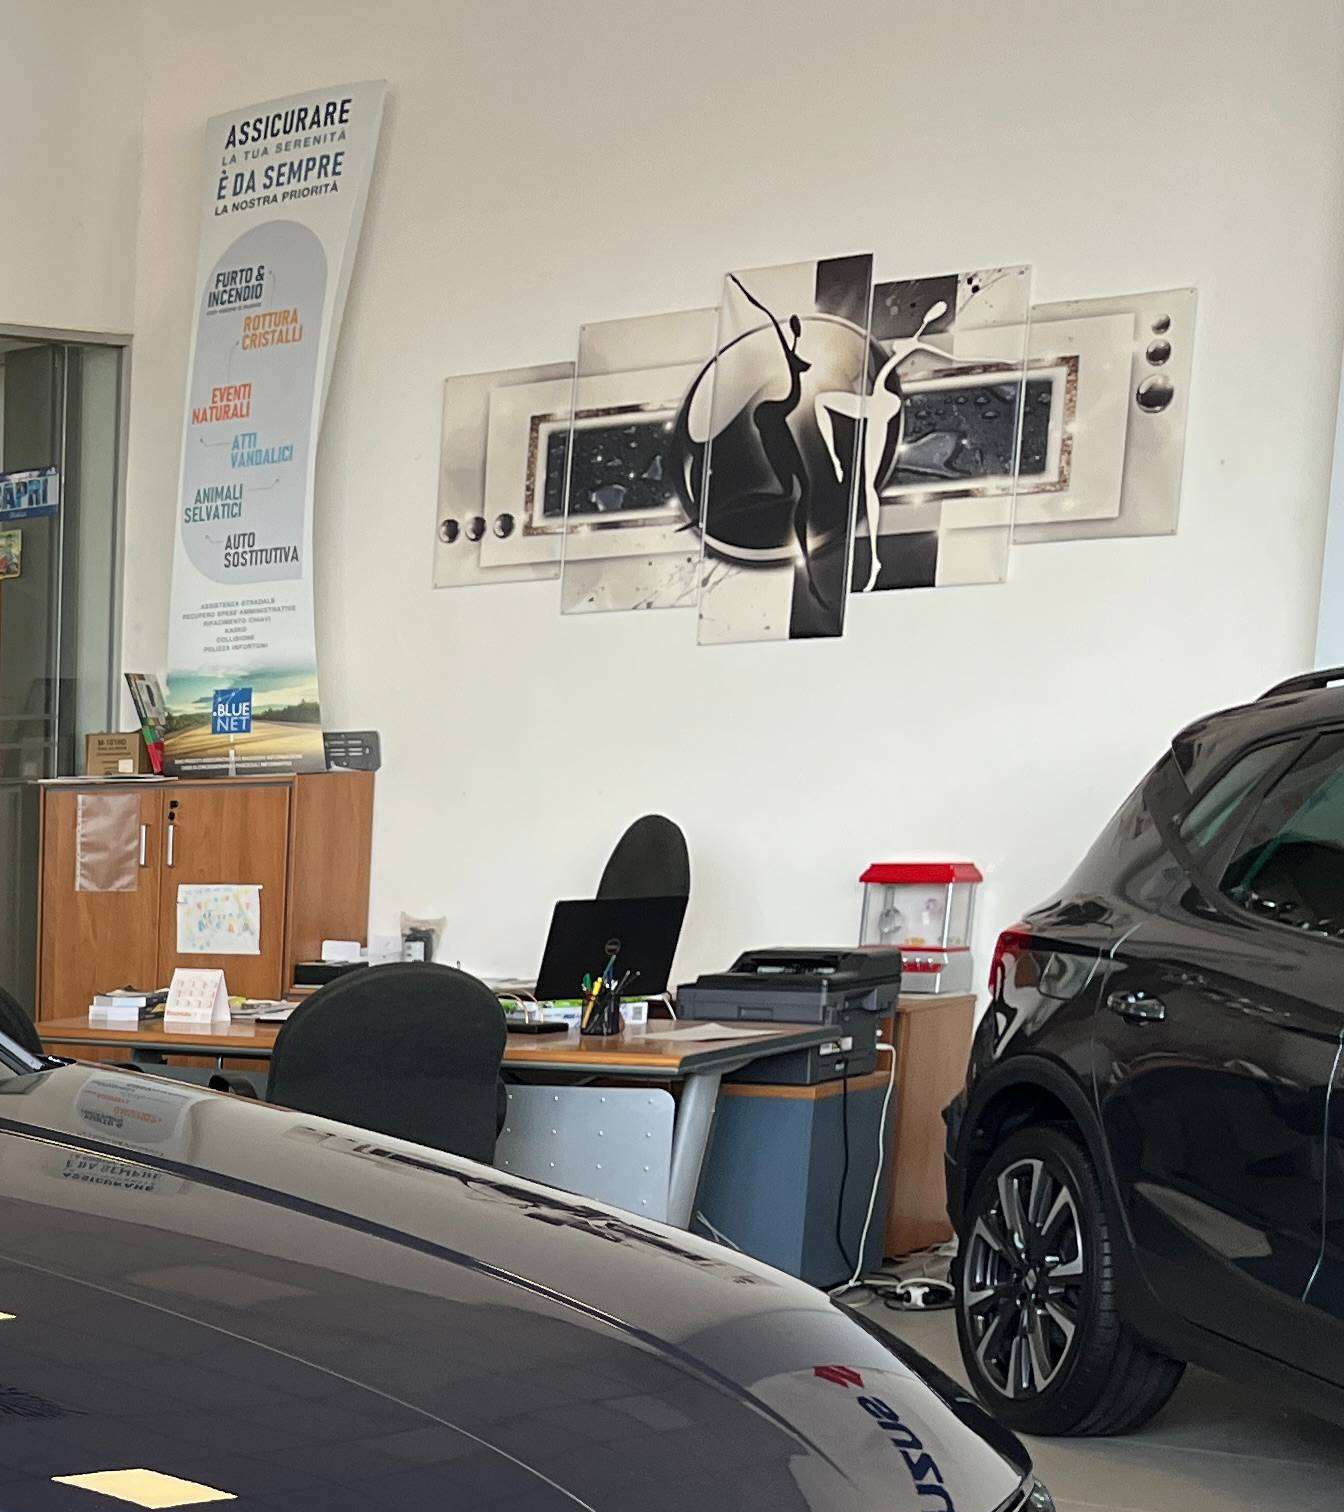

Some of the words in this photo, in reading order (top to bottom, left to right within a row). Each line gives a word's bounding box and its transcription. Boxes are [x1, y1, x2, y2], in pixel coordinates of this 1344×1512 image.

[224, 98, 353, 150] ASSICURARE
[221, 152, 238, 167] LA
[243, 146, 269, 162] TUA
[232, 169, 257, 197] DA
[262, 151, 346, 190] SEMPRE
[214, 203, 229, 217] LA
[231, 193, 279, 213] NOSTRA
[214, 267, 253, 290] FURTO
[254, 264, 265, 282] &
[207, 283, 264, 309] INCENDIO
[243, 308, 299, 333] ROTTURA
[241, 326, 304, 351] CRISTALLI
[210, 382, 252, 406] EVENTI
[191, 400, 252, 425] NATURALI
[231, 432, 258, 452] ATTI
[230, 445, 294, 469] VANDALICI
[193, 482, 244, 506] ANIMALI
[183, 501, 242, 524] SELVATICI
[224, 531, 256, 551] AUTO
[223, 544, 300, 569] SOSTITUTIVA
[216, 716, 248, 732] NET
